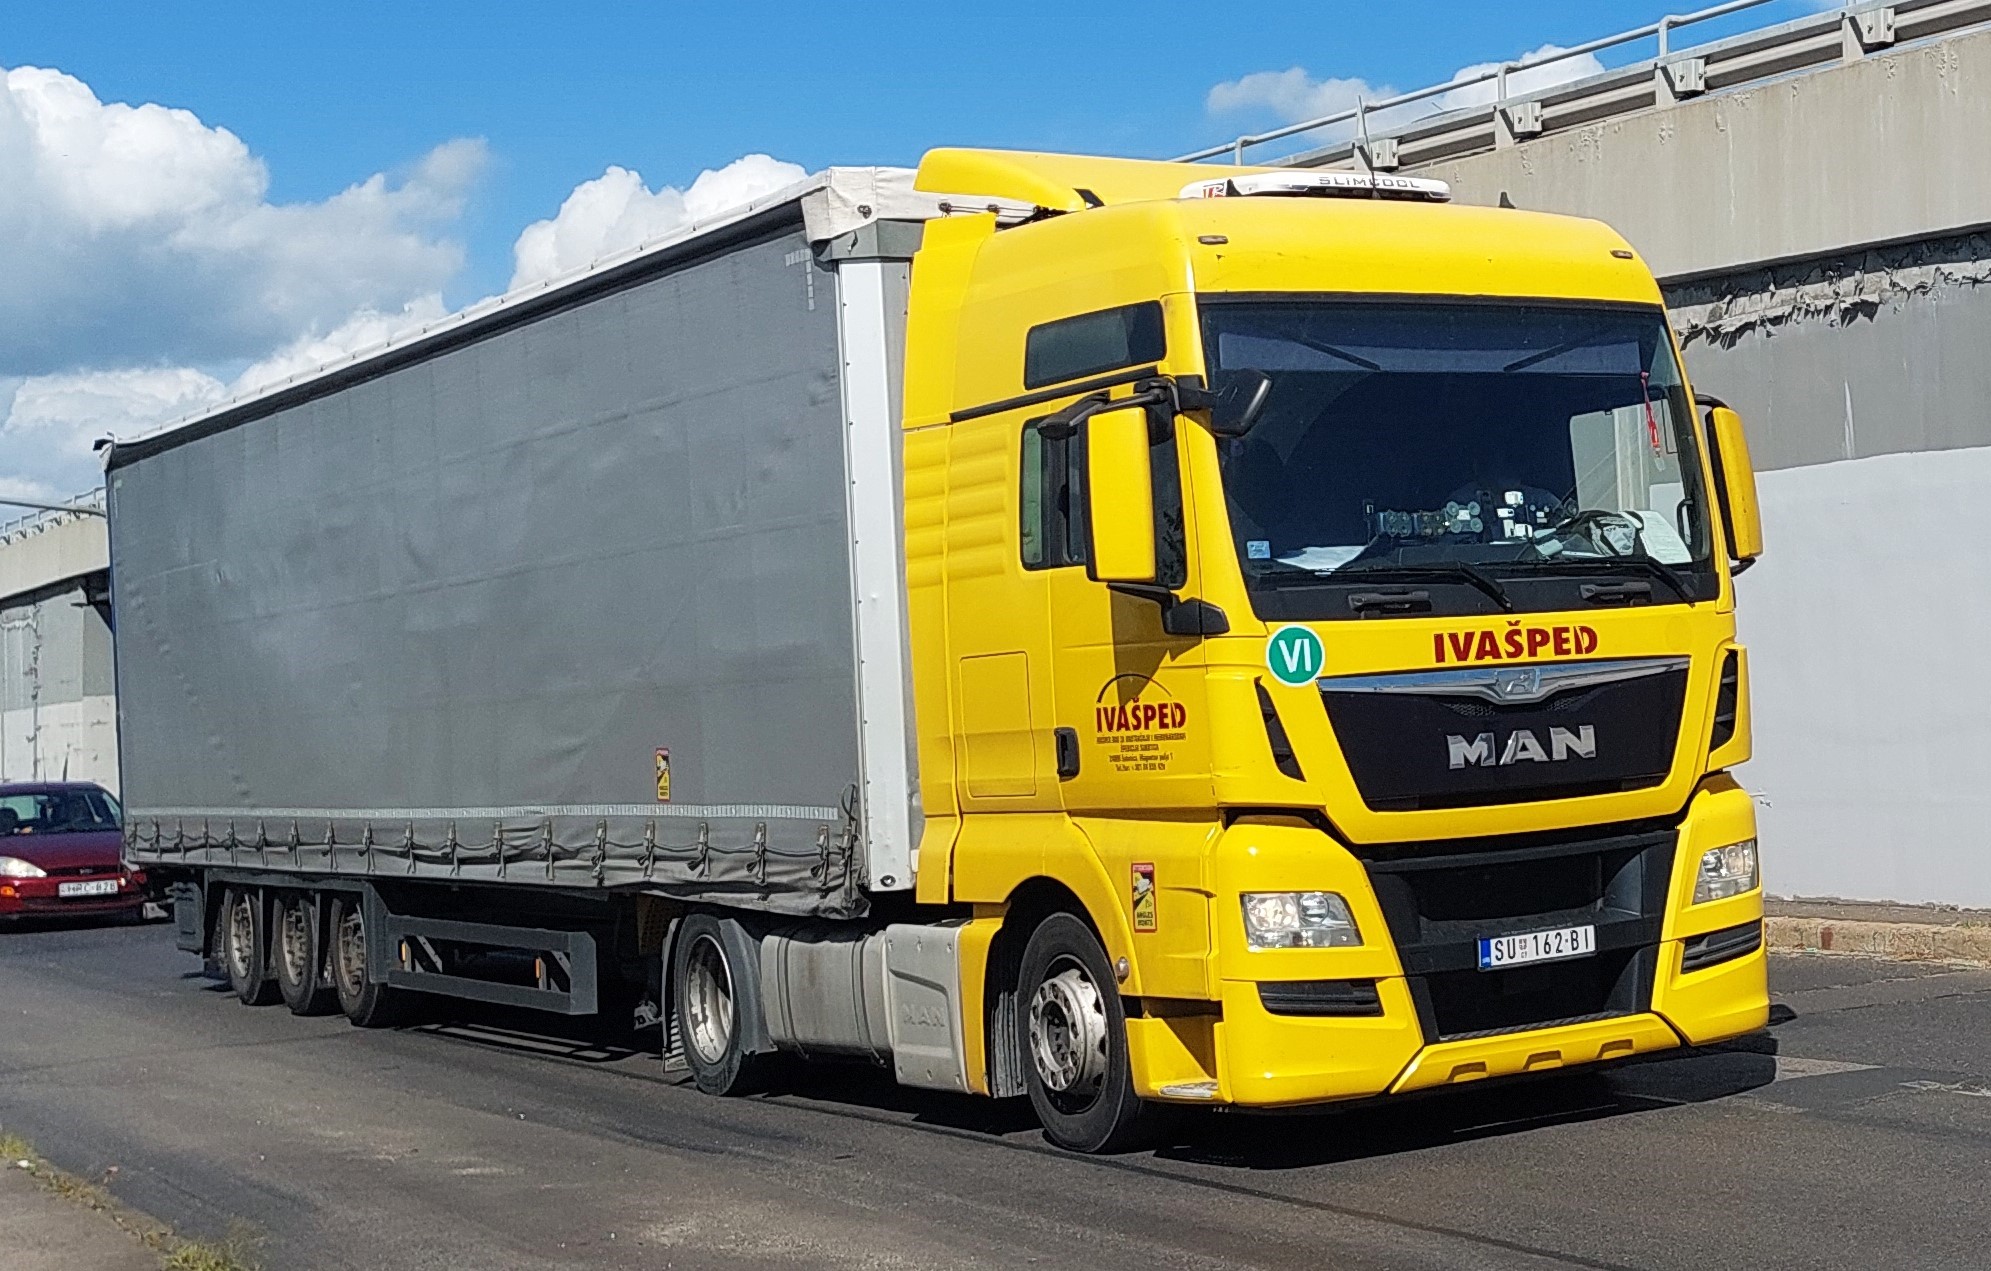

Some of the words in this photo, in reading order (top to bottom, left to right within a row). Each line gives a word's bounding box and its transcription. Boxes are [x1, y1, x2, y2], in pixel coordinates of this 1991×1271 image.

[1278, 638, 1312, 673] VI
[1434, 620, 1598, 663] IVAŠPED
[1096, 697, 1186, 733] IVAŠPED
[1446, 725, 1597, 769] MAN
[1495, 938, 1516, 961] SU
